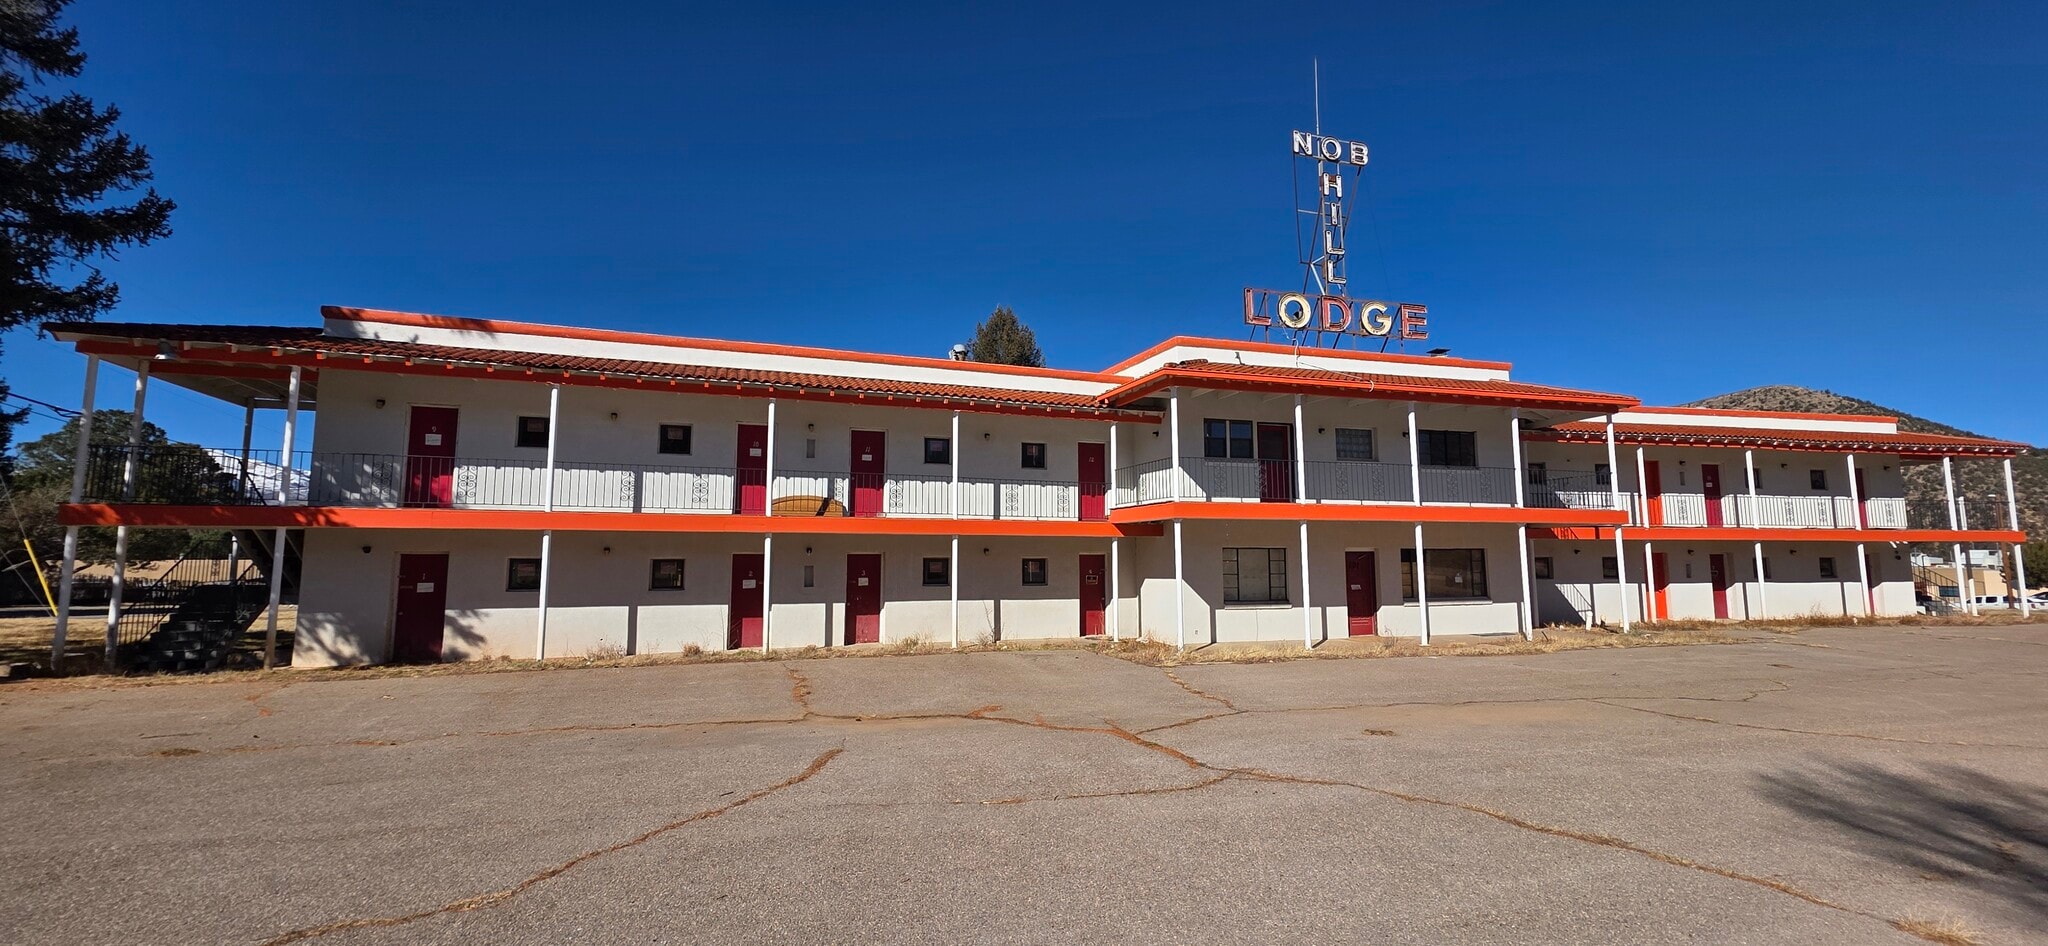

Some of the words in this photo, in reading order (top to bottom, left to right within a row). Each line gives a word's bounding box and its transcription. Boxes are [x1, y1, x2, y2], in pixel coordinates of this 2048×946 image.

[1292, 130, 1369, 166] NOB
[1323, 172, 1347, 284] HILL
[1244, 288, 1428, 339] LODGE
